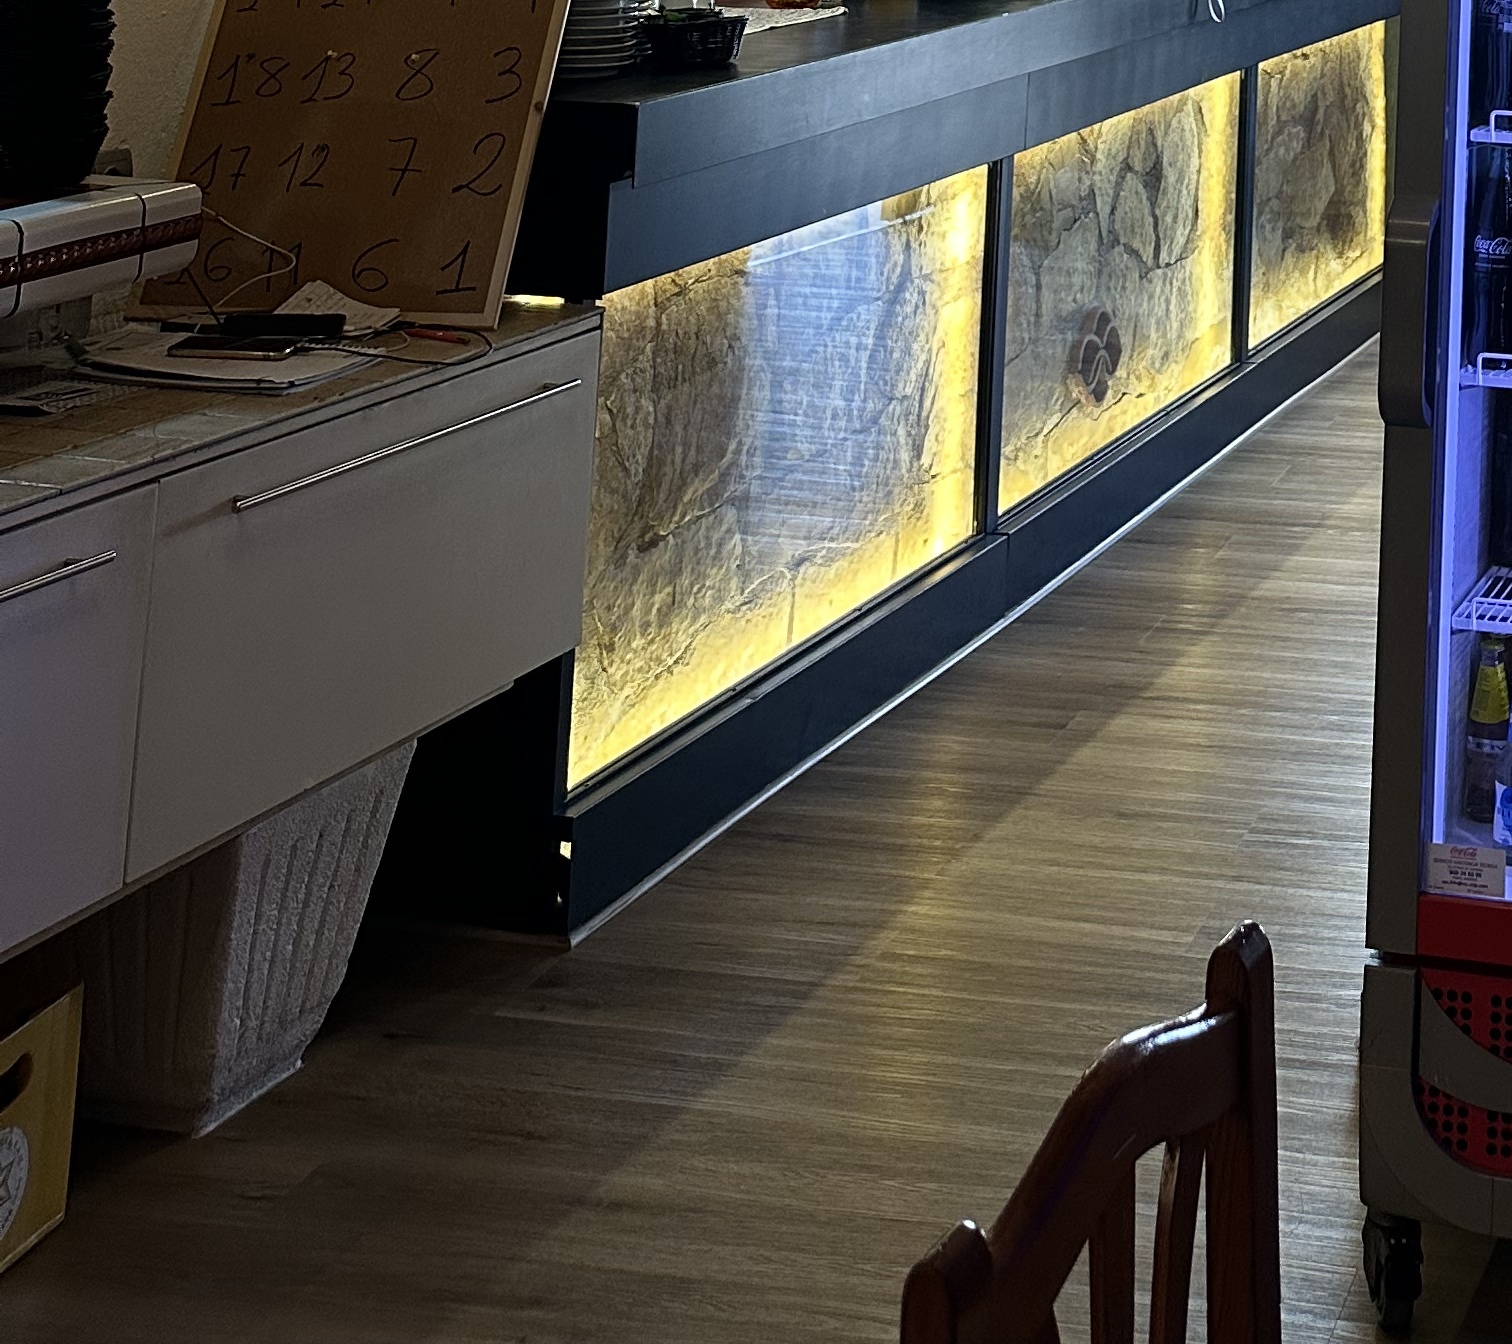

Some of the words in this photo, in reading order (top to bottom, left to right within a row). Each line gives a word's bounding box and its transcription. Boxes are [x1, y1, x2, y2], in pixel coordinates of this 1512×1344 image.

[209, 53, 291, 108] 18
[300, 51, 358, 105] 13
[395, 48, 441, 102] 8
[484, 46, 524, 105] 3
[189, 142, 252, 198] 17
[278, 140, 332, 194] 12
[387, 136, 424, 197] 7
[451, 131, 507, 197] 2
[351, 238, 400, 292] 6
[435, 239, 477, 296] 1
